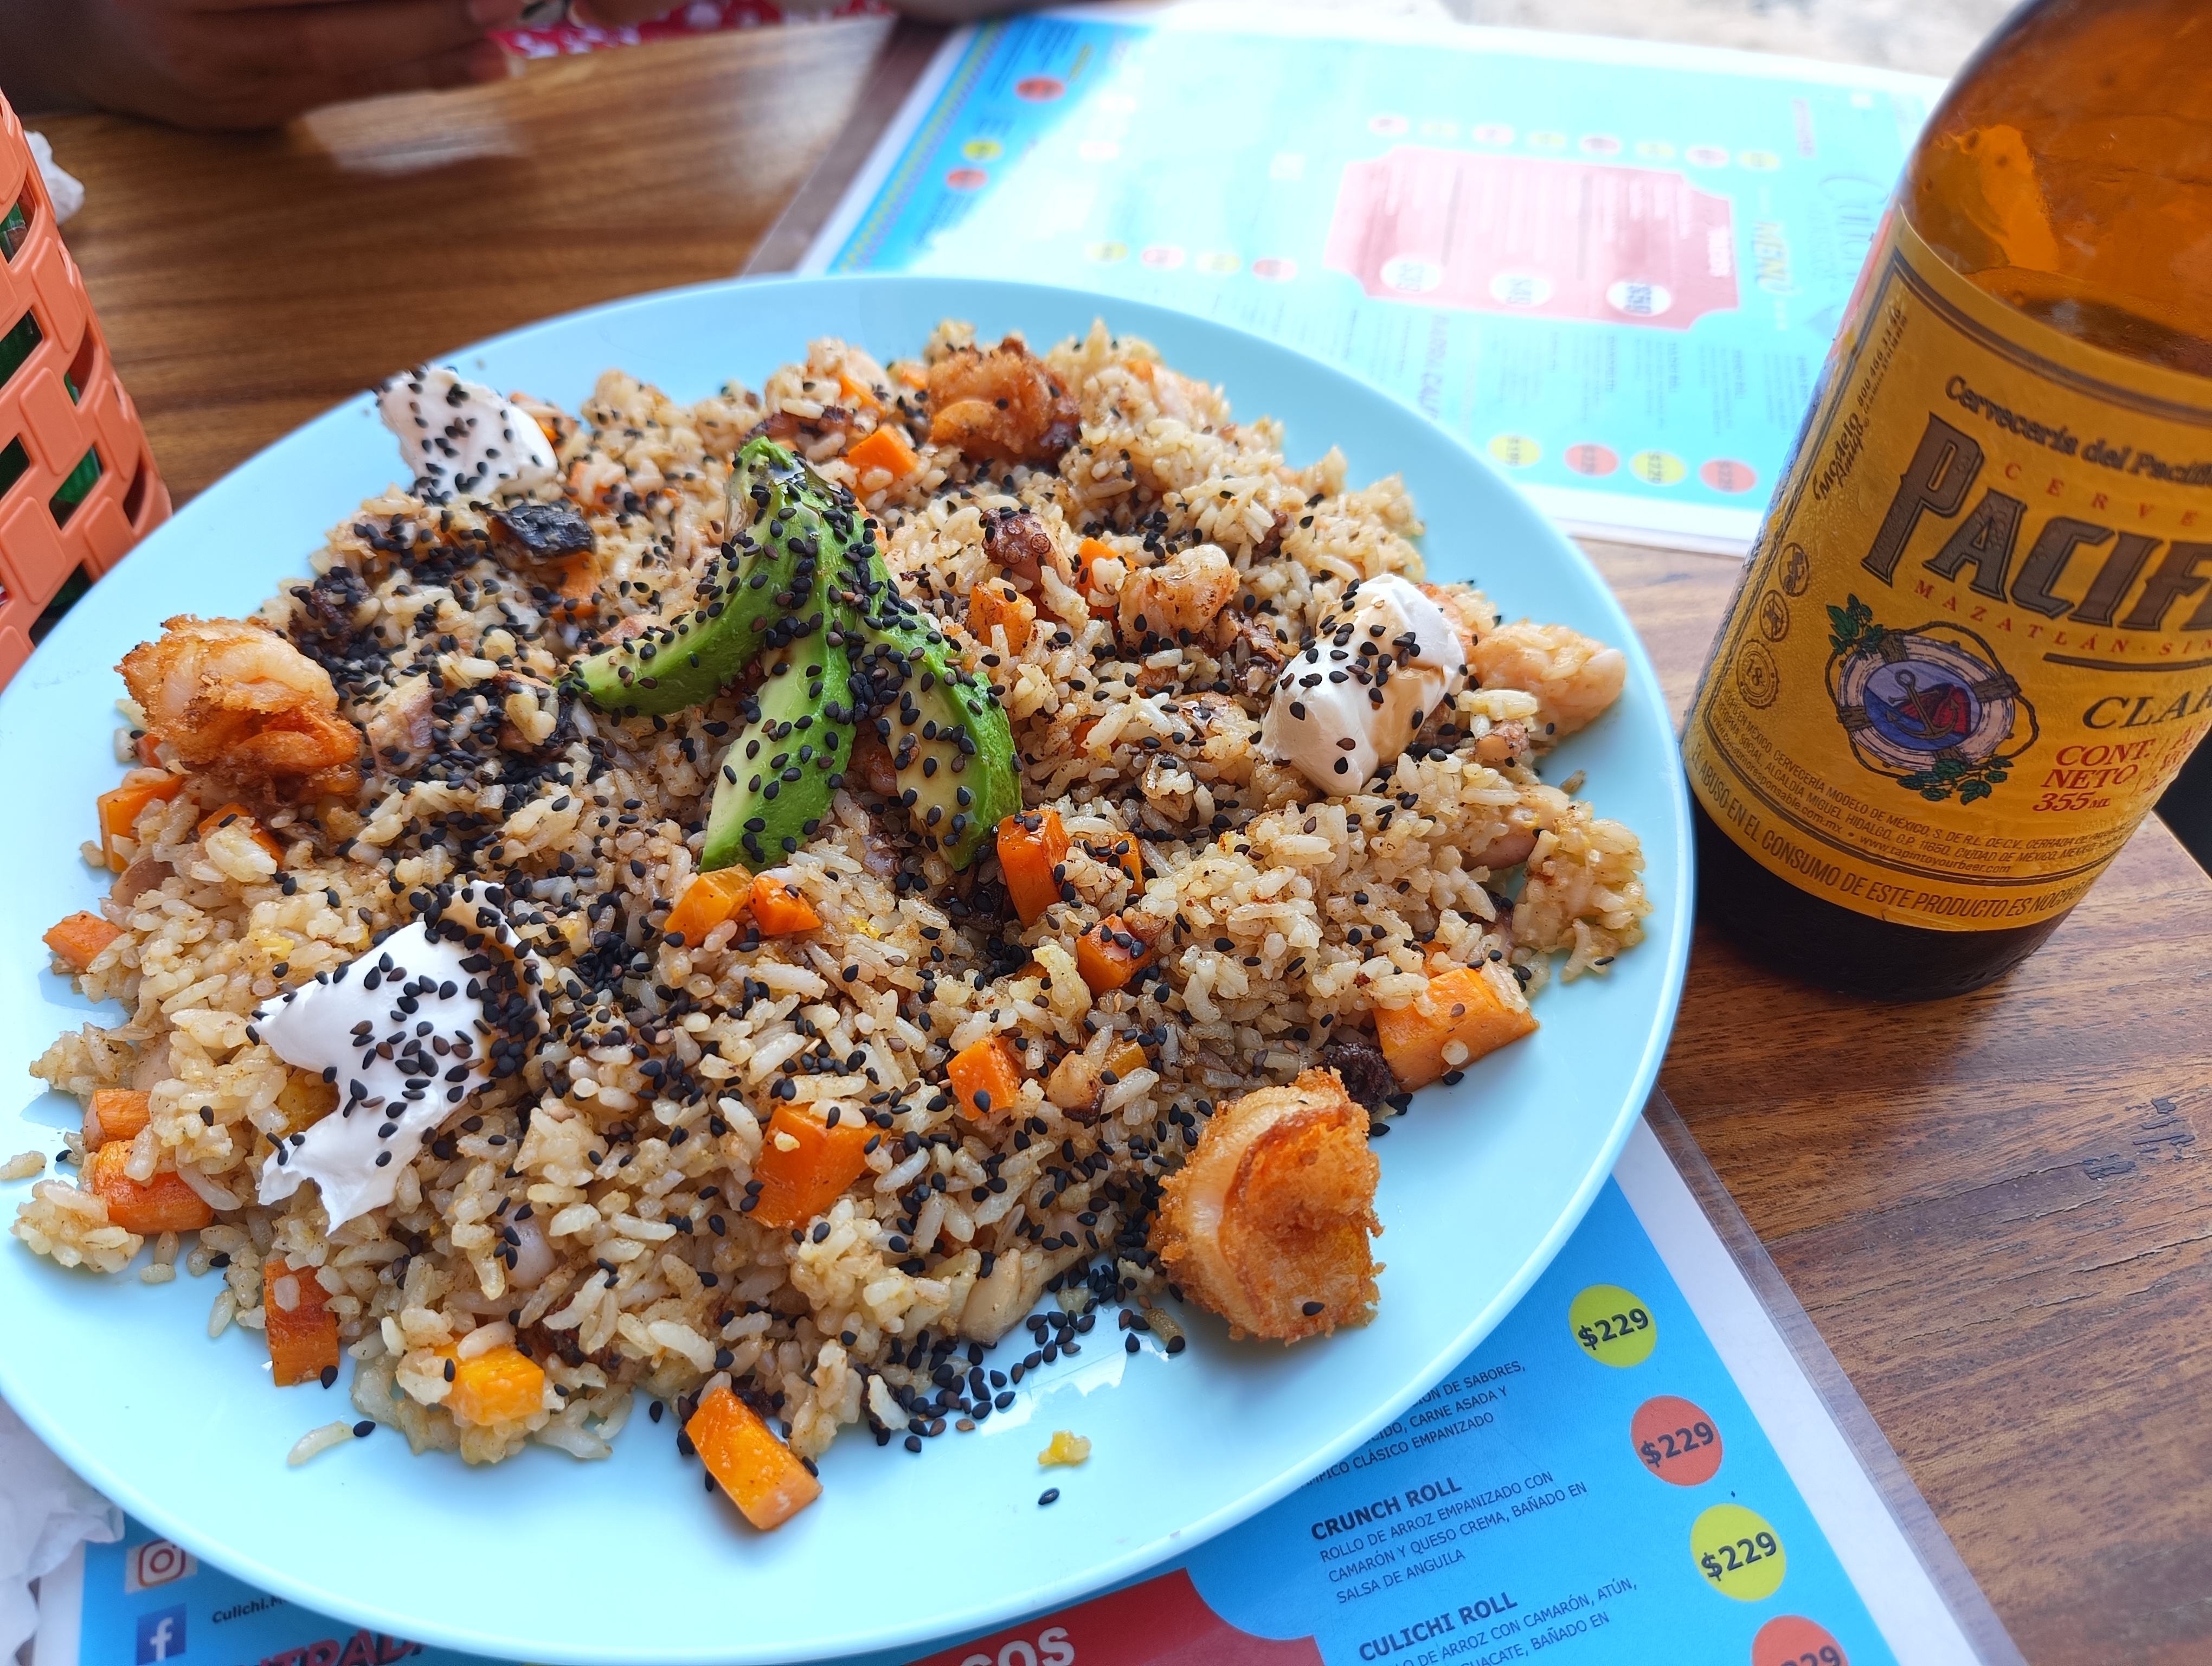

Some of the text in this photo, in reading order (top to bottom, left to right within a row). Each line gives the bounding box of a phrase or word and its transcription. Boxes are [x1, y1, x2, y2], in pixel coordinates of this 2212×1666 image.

[1819, 412, 1859, 500] Modelo
[1836, 421, 1864, 488] Amigo
[2081, 438, 2132, 471] del
[1914, 579, 2130, 652] MAZATLÁN
[2040, 764, 2138, 789] NETO
[2055, 738, 2157, 766] CONT.
[1739, 733, 1763, 767] SOCIAL,
[1764, 762, 1805, 798] ALCALDÍA
[1806, 792, 1842, 820] MIGUEL
[1954, 847, 1998, 861] CIUDAD
[1998, 852, 2017, 862] DE
[1774, 749, 1825, 793] CERVECERÍA
[1827, 786, 1869, 815] MODELO
[1869, 808, 1886, 822] DE
[1886, 815, 1930, 837] MÉXICO,
[1932, 829, 1943, 840] S.
[1945, 831, 1964, 843] DE
[1985, 838, 2003, 848] DE
[1698, 760, 1731, 808] ABUSO
[1727, 797, 1748, 827] EN
[1744, 814, 1760, 842] EL
[1761, 830, 1841, 886] CONSUMO
[1840, 872, 1869, 896] DE
[1865, 881, 1915, 908] ESTE
[1911, 892, 2009, 918] PRODUCTO
[2005, 897, 2033, 917] ES
[1860, 836, 2011, 873] www.tapintoyourbeer.com
[1577, 1308, 1649, 1350] $229
[1410, 1405, 1453, 1427] CARNE
[1456, 1391, 1499, 1412] ASADA
[1499, 1386, 1508, 1397] Y
[1443, 1381, 1462, 1396] DE
[1463, 1361, 1526, 1388] SABORES,
[1353, 1441, 1409, 1469] CLÁSICO
[1411, 1412, 1494, 1449] EMPANIZADO
[1640, 1421, 1715, 1467] $229
[1311, 1477, 1463, 1540] CRUNCH ROLL
[1320, 1471, 1554, 1563] ROLLO DE ARROZ EMPANIZADO CON
[1328, 1481, 1588, 1582] CAMARÓN Y QUESO CREMA, BAÑADO EN
[1336, 1549, 1466, 1604] SALSA DE ANGUILA
[1700, 1531, 1778, 1581] $229
[1358, 1591, 1519, 1661] CULICHI ROLL
[1417, 1578, 1638, 1666] DE ARROZ CON CAMARÓN, ATÚN,
[1531, 1620, 1587, 1651] BAÑADO
[1590, 1611, 1610, 1628] EN
